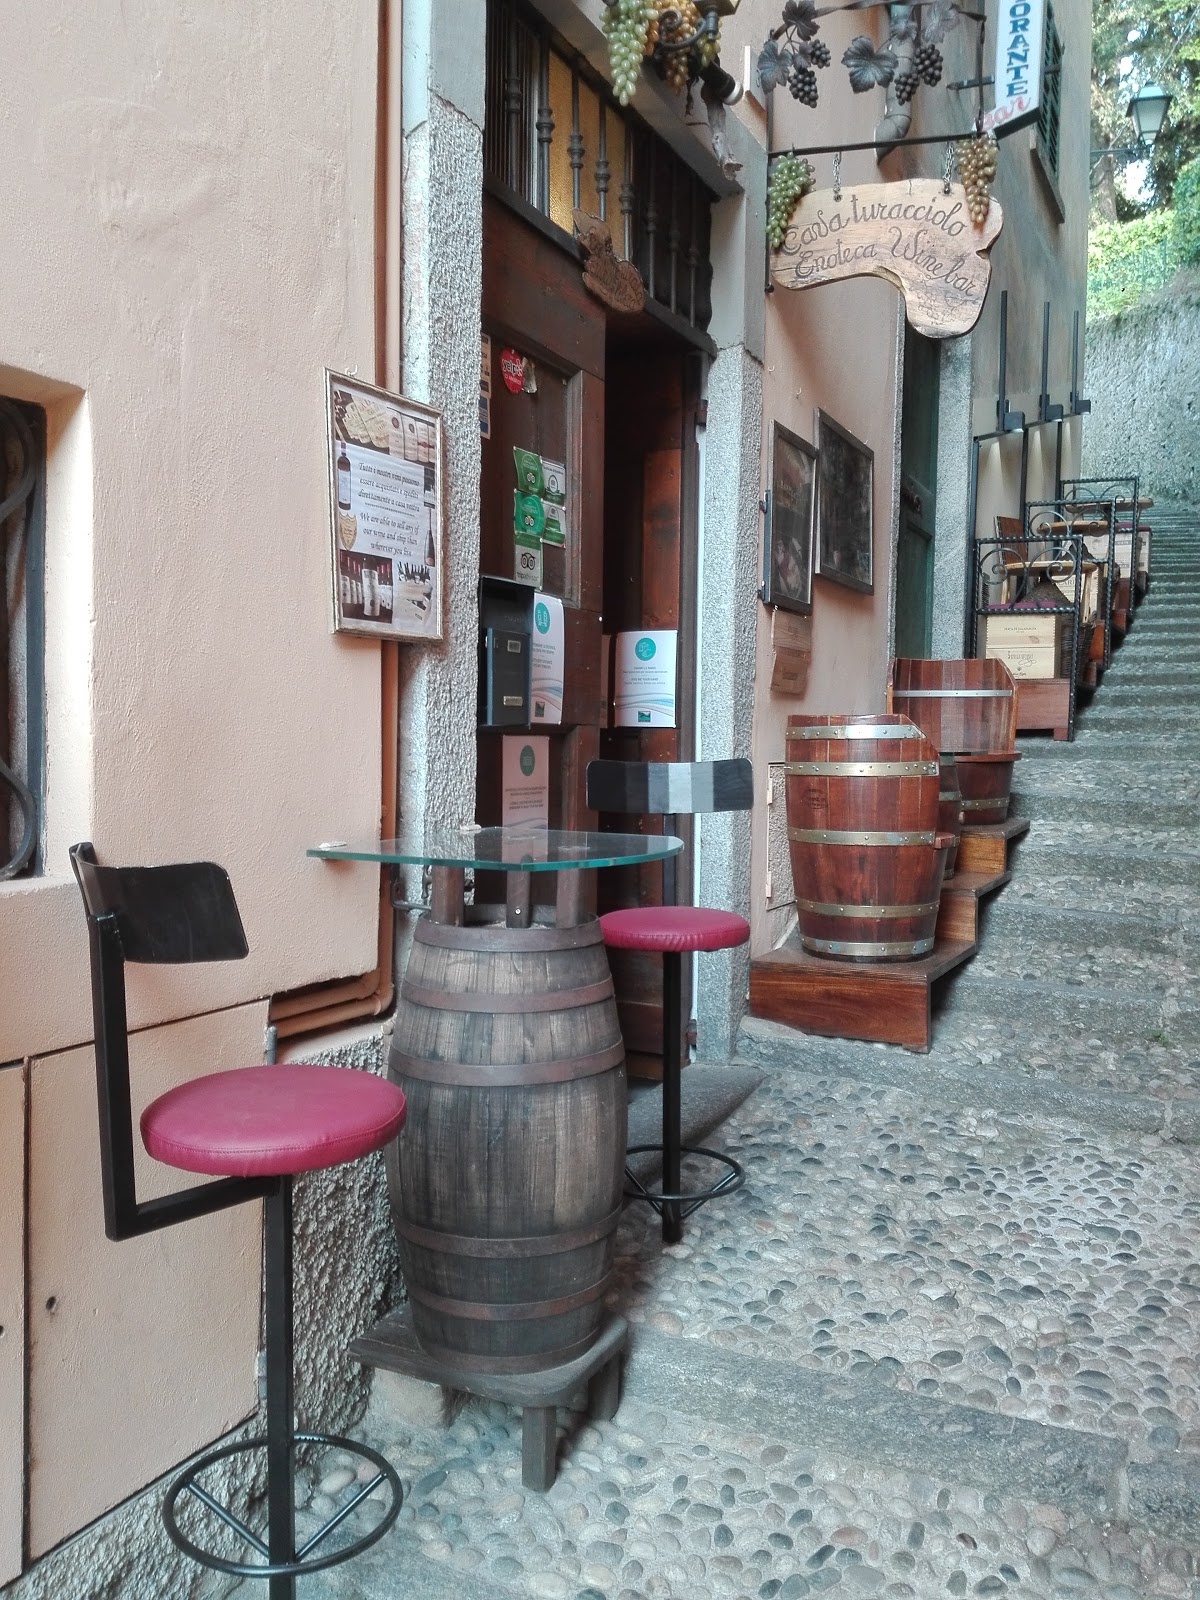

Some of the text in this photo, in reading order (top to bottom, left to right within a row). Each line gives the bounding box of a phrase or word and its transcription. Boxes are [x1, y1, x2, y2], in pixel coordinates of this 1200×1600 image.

[1006, 0, 1031, 97] ORANTE
[794, 226, 976, 297] Enoteca Wine bar
[359, 478, 374, 487] essere
[360, 512, 370, 521] We
[379, 516, 391, 526] able
[386, 532, 398, 540] and
